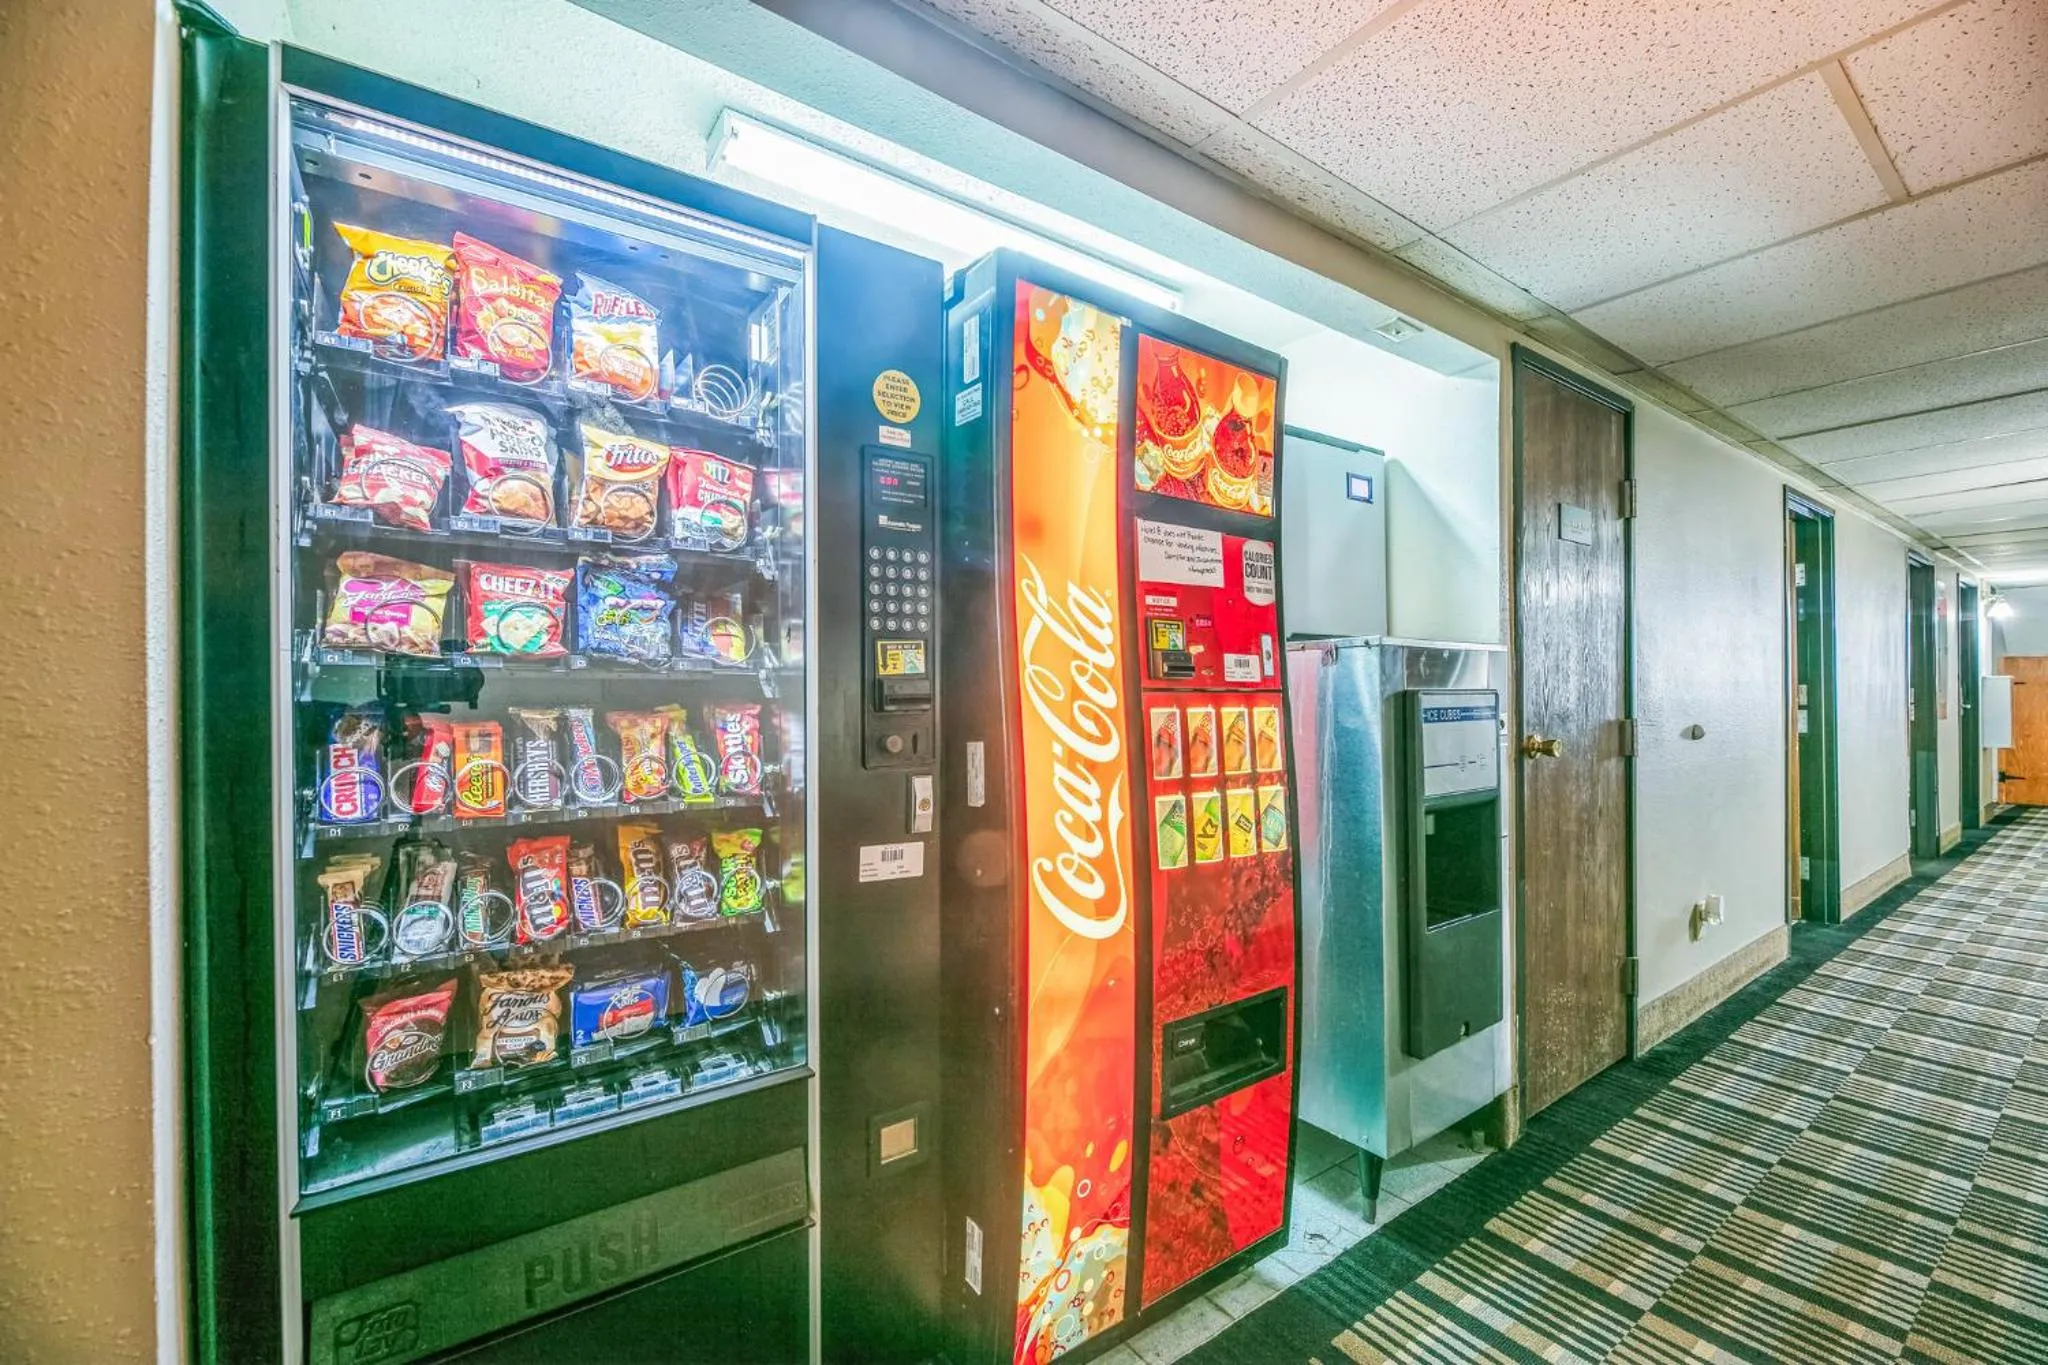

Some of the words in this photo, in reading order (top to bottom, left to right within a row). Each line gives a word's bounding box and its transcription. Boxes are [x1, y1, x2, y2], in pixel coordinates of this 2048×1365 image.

[884, 375, 910, 386] PLEASE
[877, 389, 915, 404] SELECTION
[885, 384, 908, 394] ENTER
[882, 400, 892, 409] TO
[894, 402, 912, 411] VIEW
[886, 410, 907, 419] PRICE
[604, 443, 660, 467] Fritos
[703, 458, 730, 485] RITZ
[1243, 549, 1273, 565] CALORIES
[1244, 562, 1273, 581] COUNT
[326, 653, 338, 664] C1
[1425, 710, 1438, 721] ICE
[1021, 552, 1128, 940] Coca-Cola
[333, 746, 358, 818] CRUNCH
[522, 814, 532, 822] D4
[329, 827, 341, 837] D1
[398, 823, 410, 832] D2
[632, 839, 658, 911] m&m's
[721, 857, 738, 897] SOUR
[519, 855, 551, 932] m&m's
[334, 903, 357, 961] SNICKERS
[401, 963, 412, 972] E2
[332, 973, 344, 983] E1
[483, 991, 551, 1016] Famous
[486, 1007, 543, 1029] Amos
[575, 1030, 585, 1040] 2
[331, 1110, 343, 1120] F1
[525, 1212, 659, 1310] PUSH
